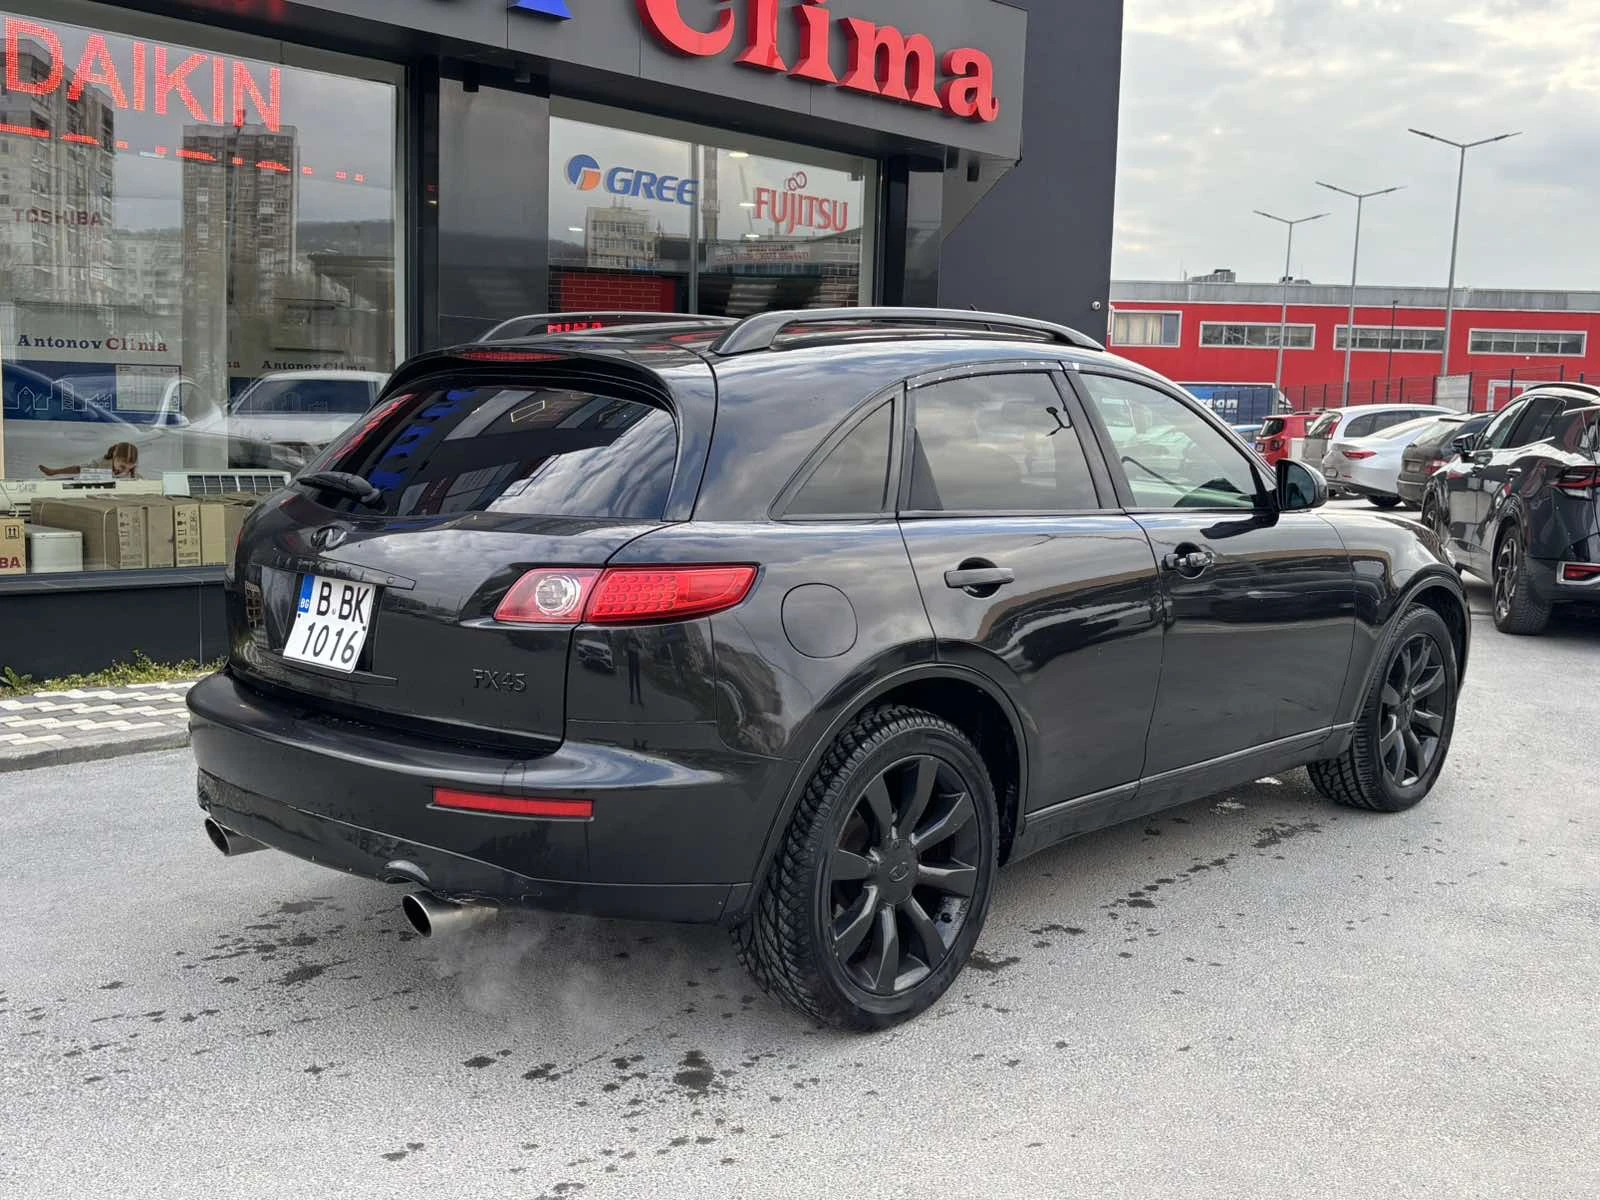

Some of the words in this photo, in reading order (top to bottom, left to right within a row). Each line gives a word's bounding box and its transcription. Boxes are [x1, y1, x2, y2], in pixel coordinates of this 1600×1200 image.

[5, 16, 282, 133] DAIKIN
[605, 166, 700, 206] GREE
[12, 207, 104, 226] TOSHIBA
[752, 186, 849, 234] FUJITSU
[17, 334, 102, 349] Antonov
[105, 337, 168, 352] Clima
[300, 598, 310, 609] BG
[301, 622, 359, 664] 1016
[472, 668, 527, 692] FX45
